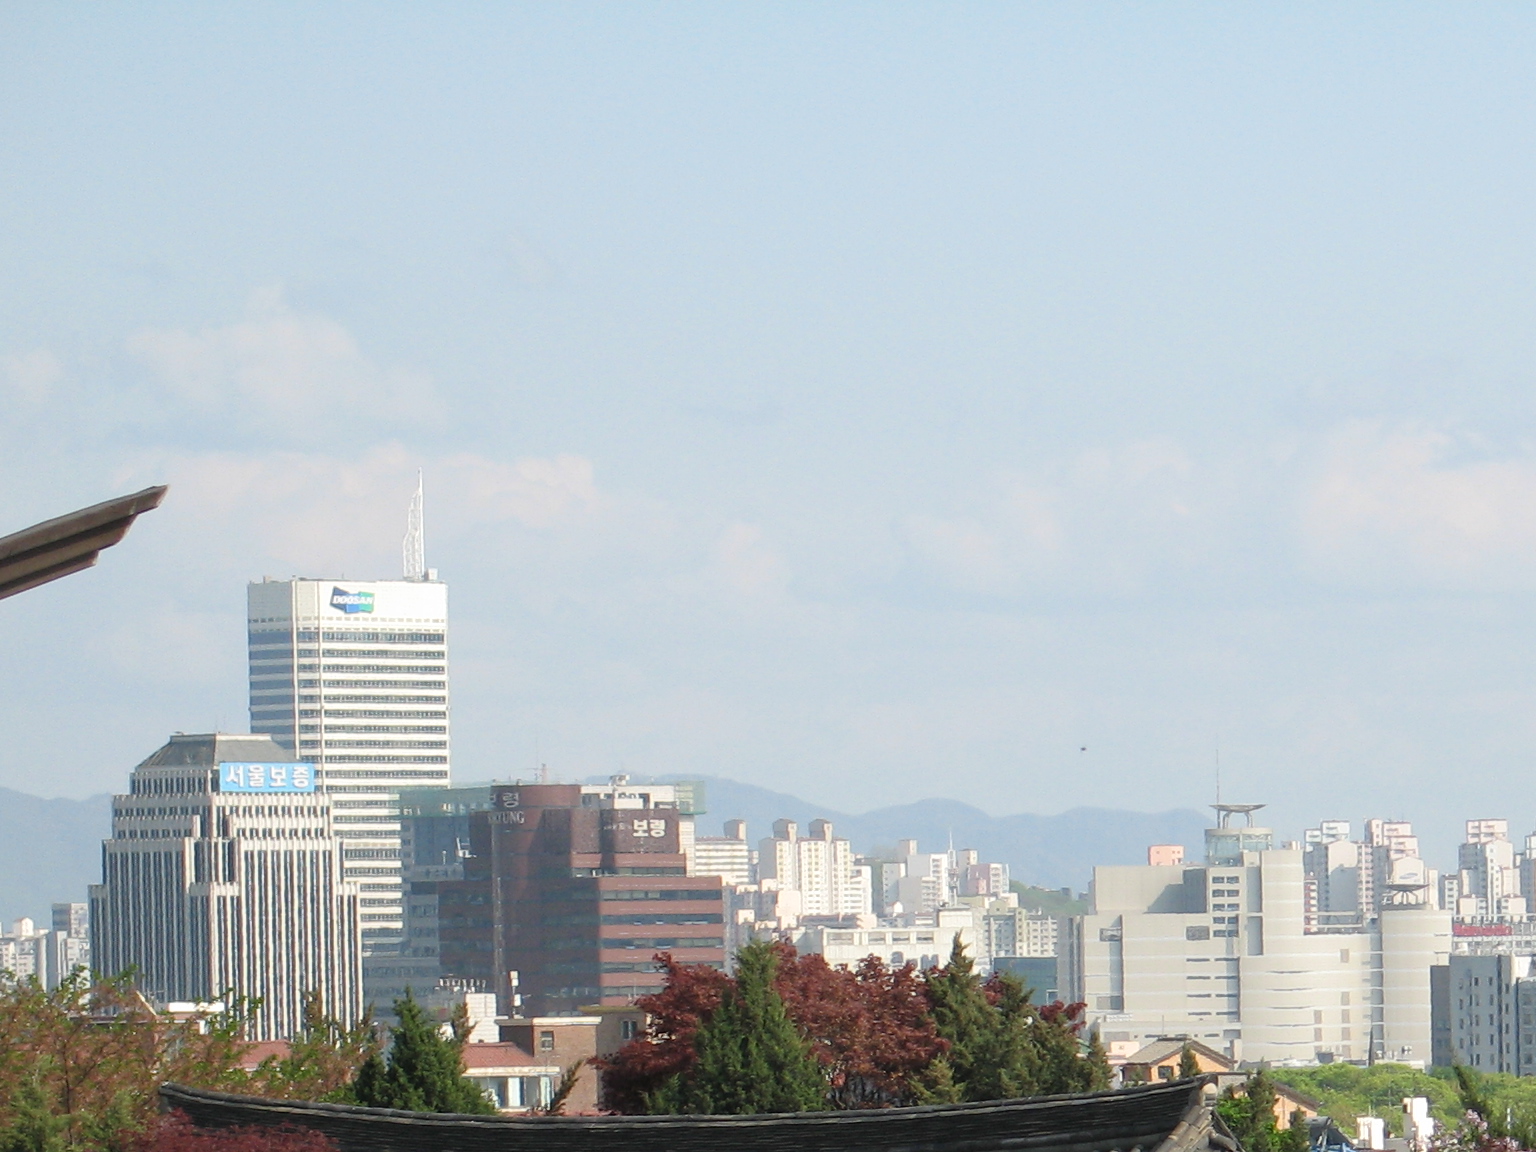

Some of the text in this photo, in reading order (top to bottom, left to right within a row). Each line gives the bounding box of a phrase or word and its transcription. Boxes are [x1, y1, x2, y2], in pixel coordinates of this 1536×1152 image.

[332, 595, 375, 605] DOOSAN
[225, 765, 310, 788] 서울보증
[632, 819, 666, 837] 보령
